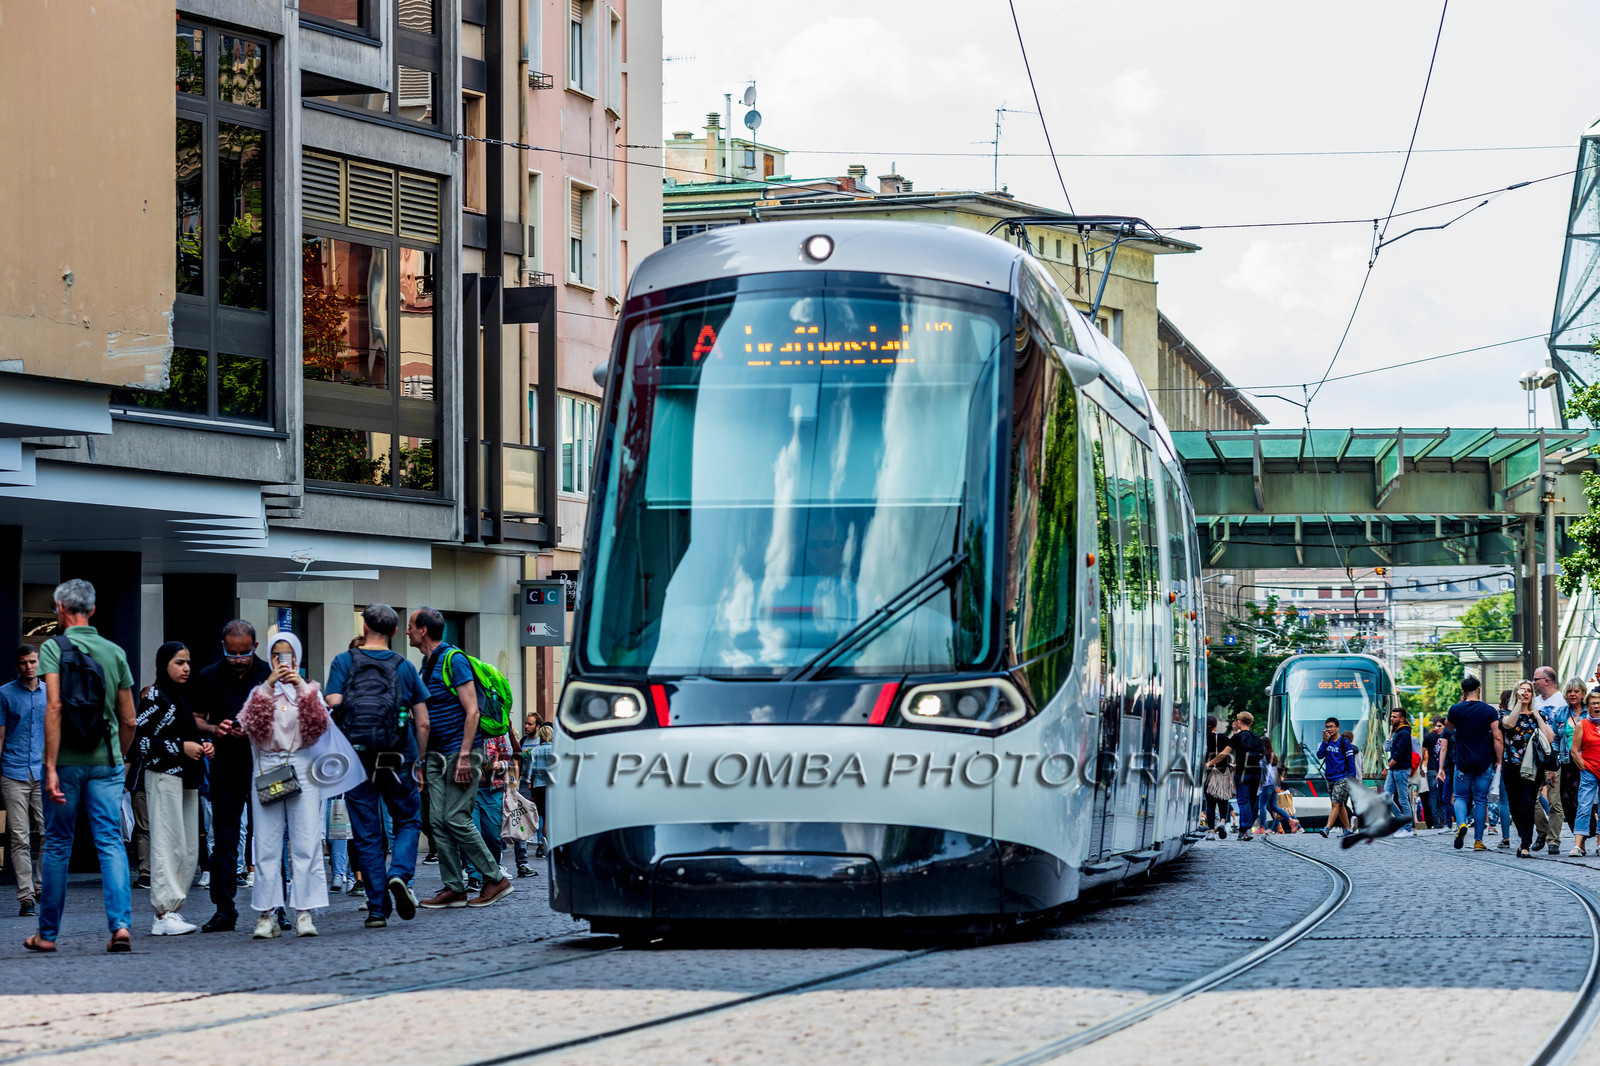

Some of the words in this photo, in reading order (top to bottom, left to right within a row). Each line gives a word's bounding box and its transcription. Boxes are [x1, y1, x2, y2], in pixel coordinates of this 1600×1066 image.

[692, 325, 723, 361] A
[529, 591, 556, 601] CIC
[1318, 680, 1333, 689] des
[1334, 679, 1363, 690] Sports
